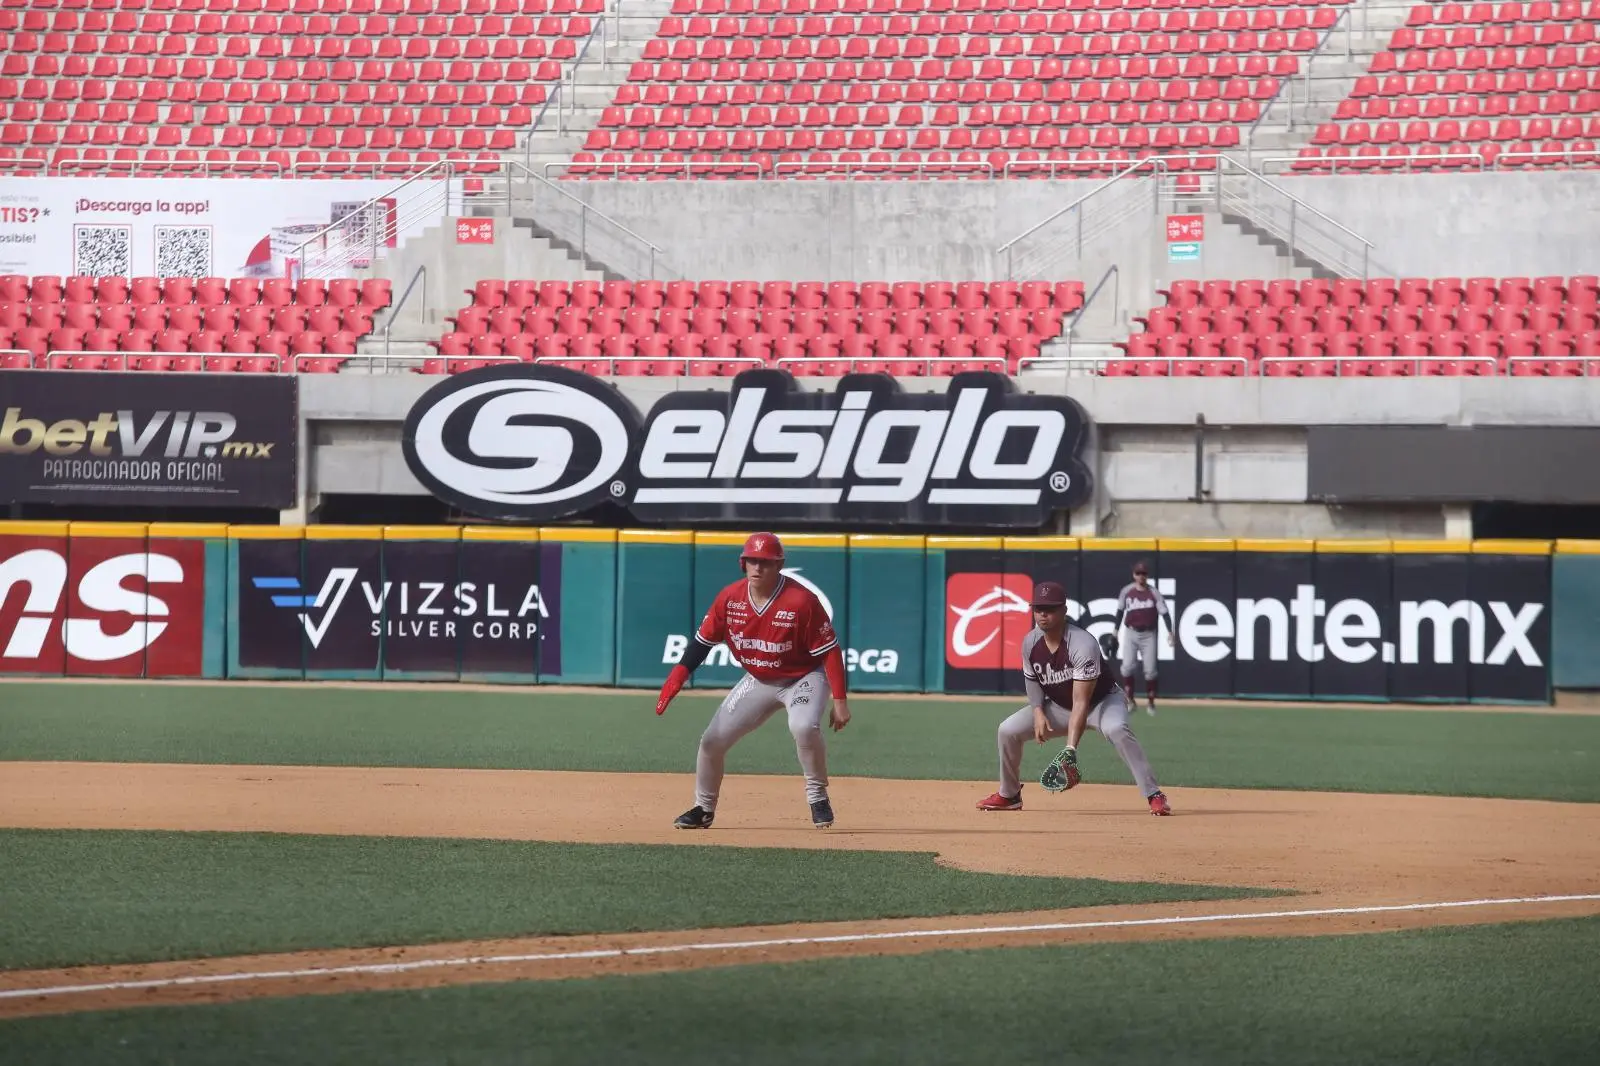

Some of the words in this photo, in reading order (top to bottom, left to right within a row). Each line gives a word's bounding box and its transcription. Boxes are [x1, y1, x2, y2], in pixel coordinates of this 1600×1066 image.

[76, 199, 152, 215] ¡Descarga
[156, 199, 170, 212] la
[174, 200, 210, 215] app!
[633, 387, 1066, 503] elsiglo
[43, 459, 161, 480] PATROCINADOR
[167, 461, 225, 481] OFICIAL
[361, 581, 549, 618] VIZSLA
[371, 620, 457, 637] SILVER
[472, 622, 546, 640] CORP.
